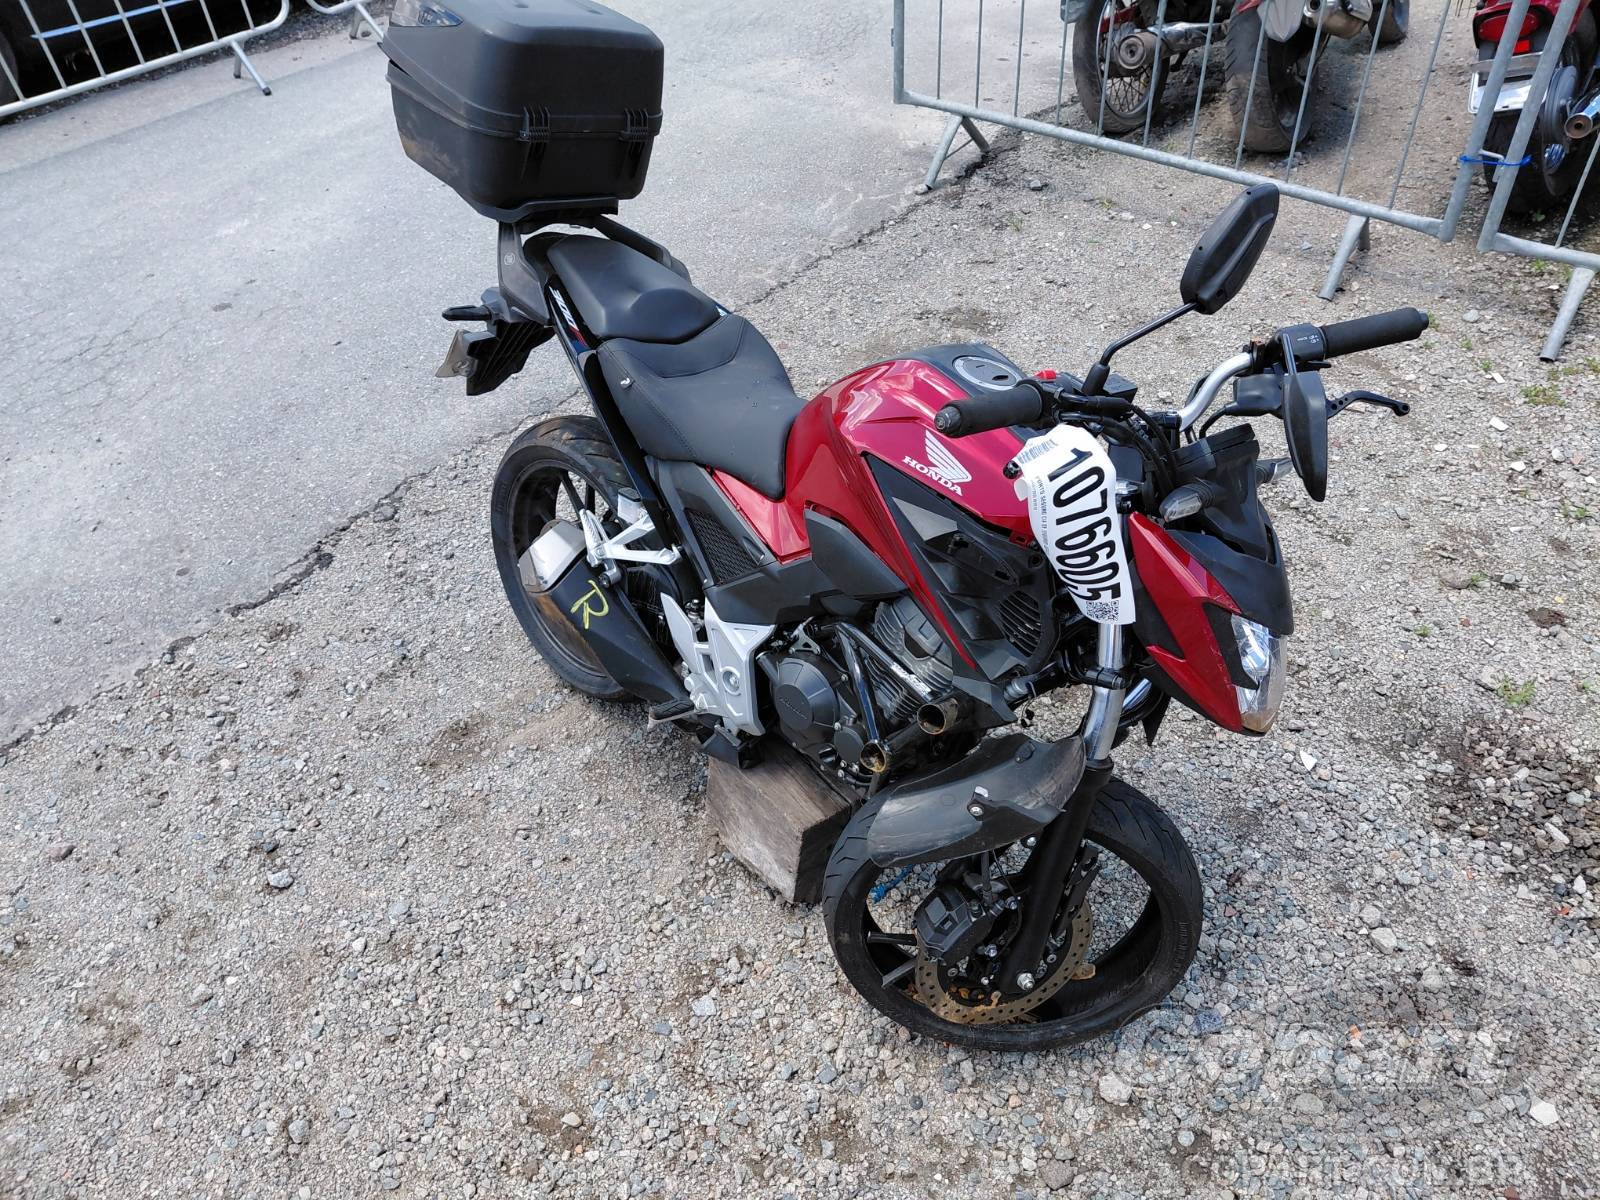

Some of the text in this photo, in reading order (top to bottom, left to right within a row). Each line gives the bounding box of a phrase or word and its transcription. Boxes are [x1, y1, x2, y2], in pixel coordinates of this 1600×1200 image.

[901, 455, 963, 497] HONDA
[1048, 447, 1121, 602] 1076605
[569, 579, 610, 630] R
